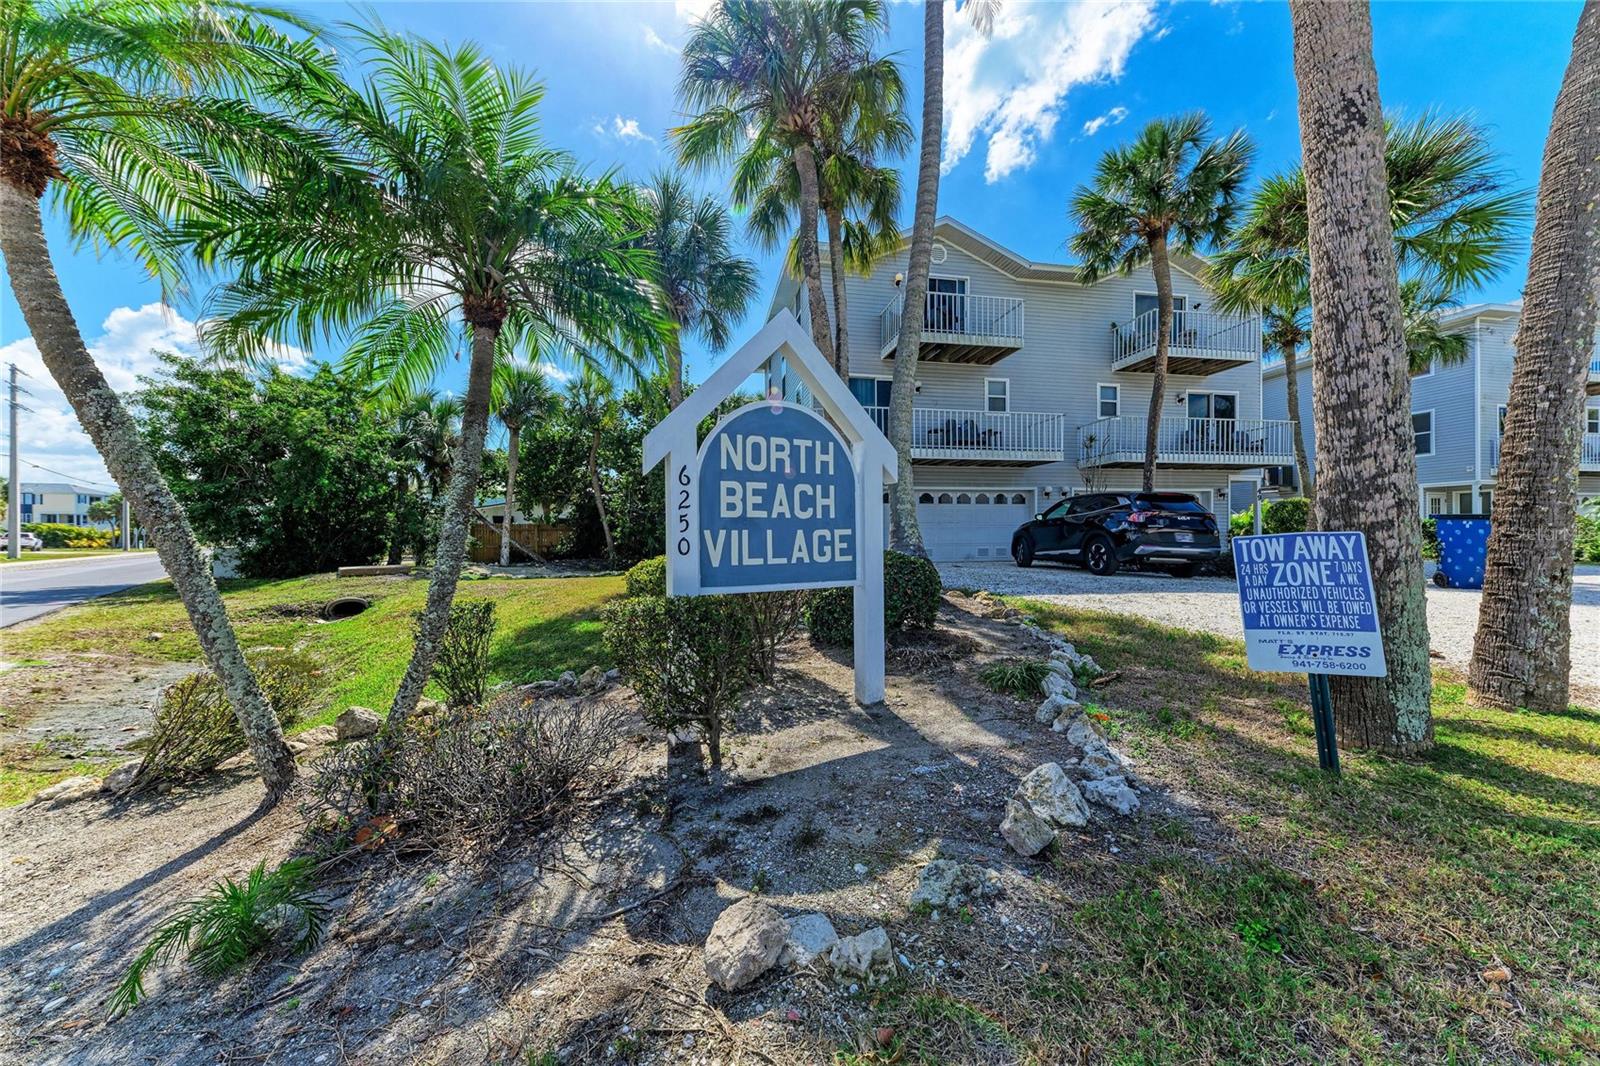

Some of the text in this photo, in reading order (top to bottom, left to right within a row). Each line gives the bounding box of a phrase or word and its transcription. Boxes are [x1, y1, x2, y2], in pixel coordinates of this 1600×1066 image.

[720, 433, 834, 475] NORTH
[720, 480, 835, 519] BEACH
[678, 465, 691, 556] 6250
[704, 529, 853, 568] VILLAGE
[1238, 536, 1356, 562] TOW AWAY
[1241, 563, 1269, 575] 24 HRS
[1271, 562, 1335, 586] ZONE
[1334, 561, 1363, 573] 7 DAYS
[1245, 575, 1268, 587] A DAY
[1340, 574, 1362, 585] A WK.
[1246, 586, 1365, 600] UNAUTHORIZED VEHICLES
[1244, 600, 1372, 615] OR VESSELS WILL BE TOWED
[1260, 614, 1361, 629] AT OWNER'S EXPENSE
[1278, 644, 1371, 657] EXPRESS
[1292, 660, 1367, 670] 941-758-6200
